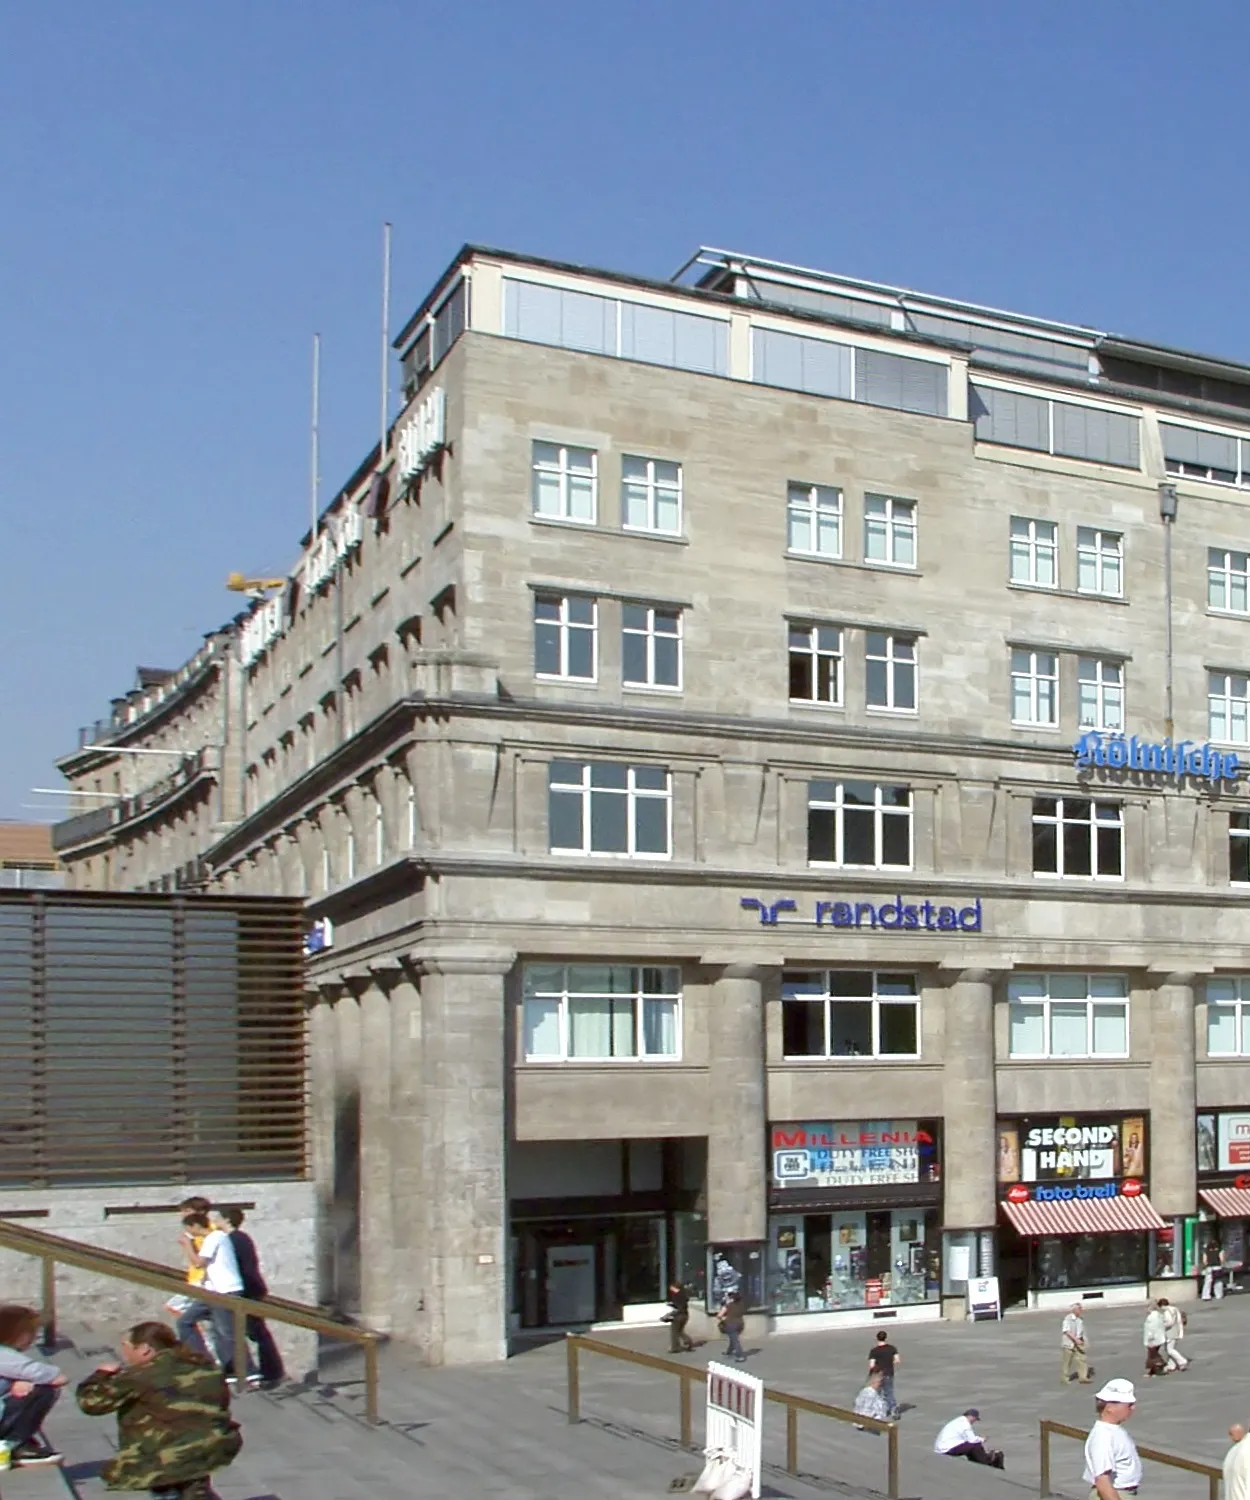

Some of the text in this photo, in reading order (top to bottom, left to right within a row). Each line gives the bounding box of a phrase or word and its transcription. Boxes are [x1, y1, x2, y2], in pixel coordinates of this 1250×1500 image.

[1074, 730, 1239, 781] Kölnische
[816, 894, 982, 932] randstad
[774, 1130, 933, 1147] MILLENIA
[1029, 1126, 1114, 1146] SECOND
[818, 1148, 855, 1159] DUTY
[861, 1147, 892, 1158] FREE
[1040, 1150, 1104, 1169] HAND
[1036, 1186, 1073, 1200] foto
